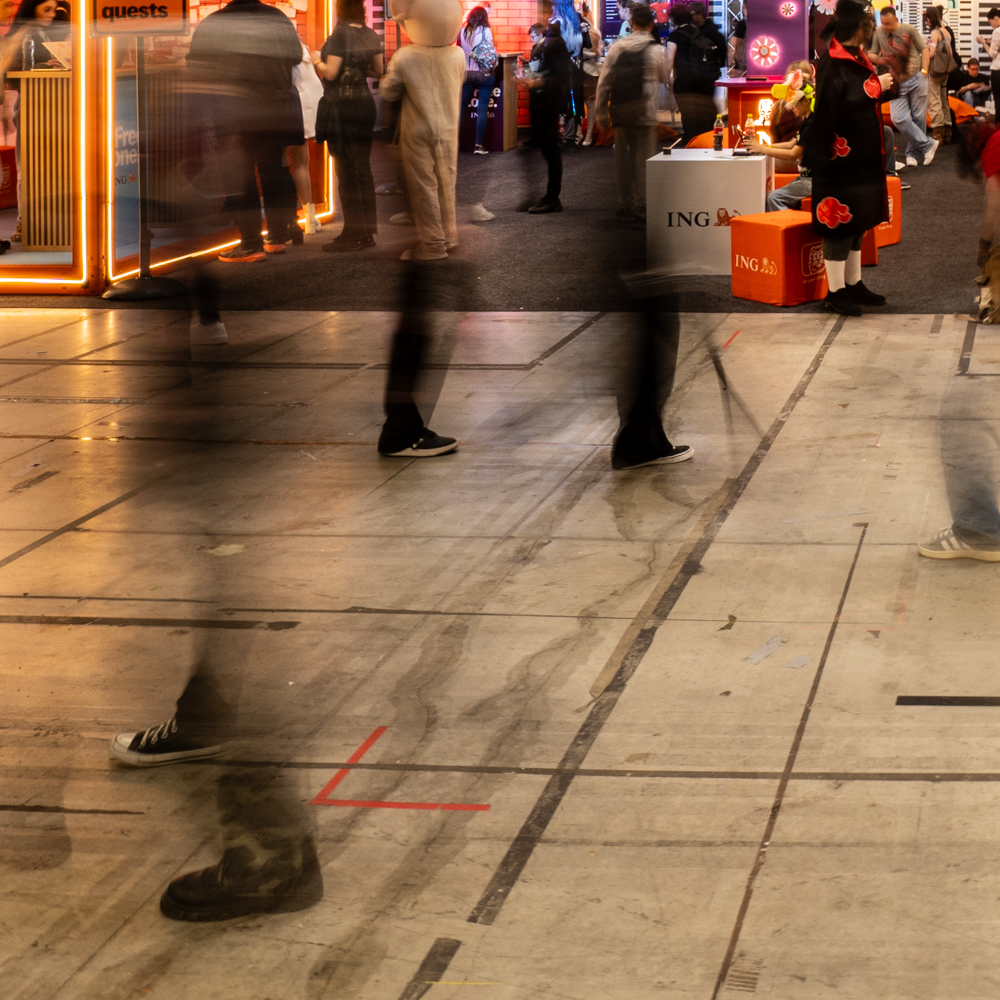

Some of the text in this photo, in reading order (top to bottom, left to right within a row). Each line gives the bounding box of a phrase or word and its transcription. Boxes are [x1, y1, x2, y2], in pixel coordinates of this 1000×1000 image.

[101, 3, 168, 23] quests
[667, 211, 711, 228] ING
[735, 254, 759, 271] ING
